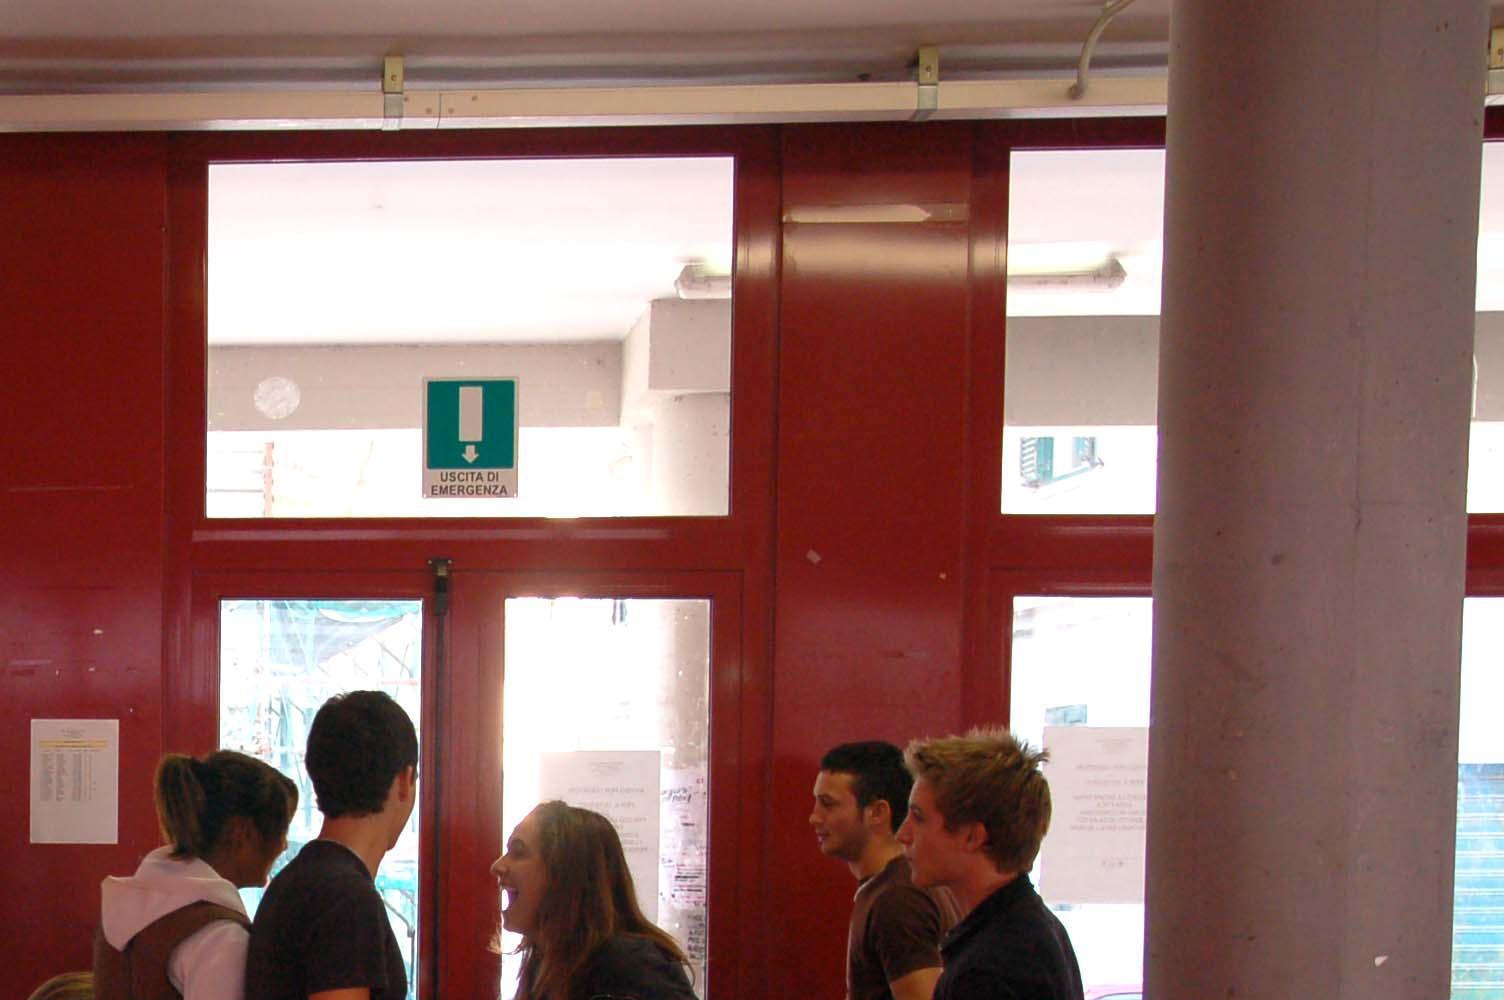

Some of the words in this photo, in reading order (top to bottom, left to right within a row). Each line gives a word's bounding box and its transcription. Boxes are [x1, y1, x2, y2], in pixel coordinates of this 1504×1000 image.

[440, 471, 484, 482] USCITA
[487, 471, 499, 482] DI
[430, 484, 508, 496] EMERGENZA
